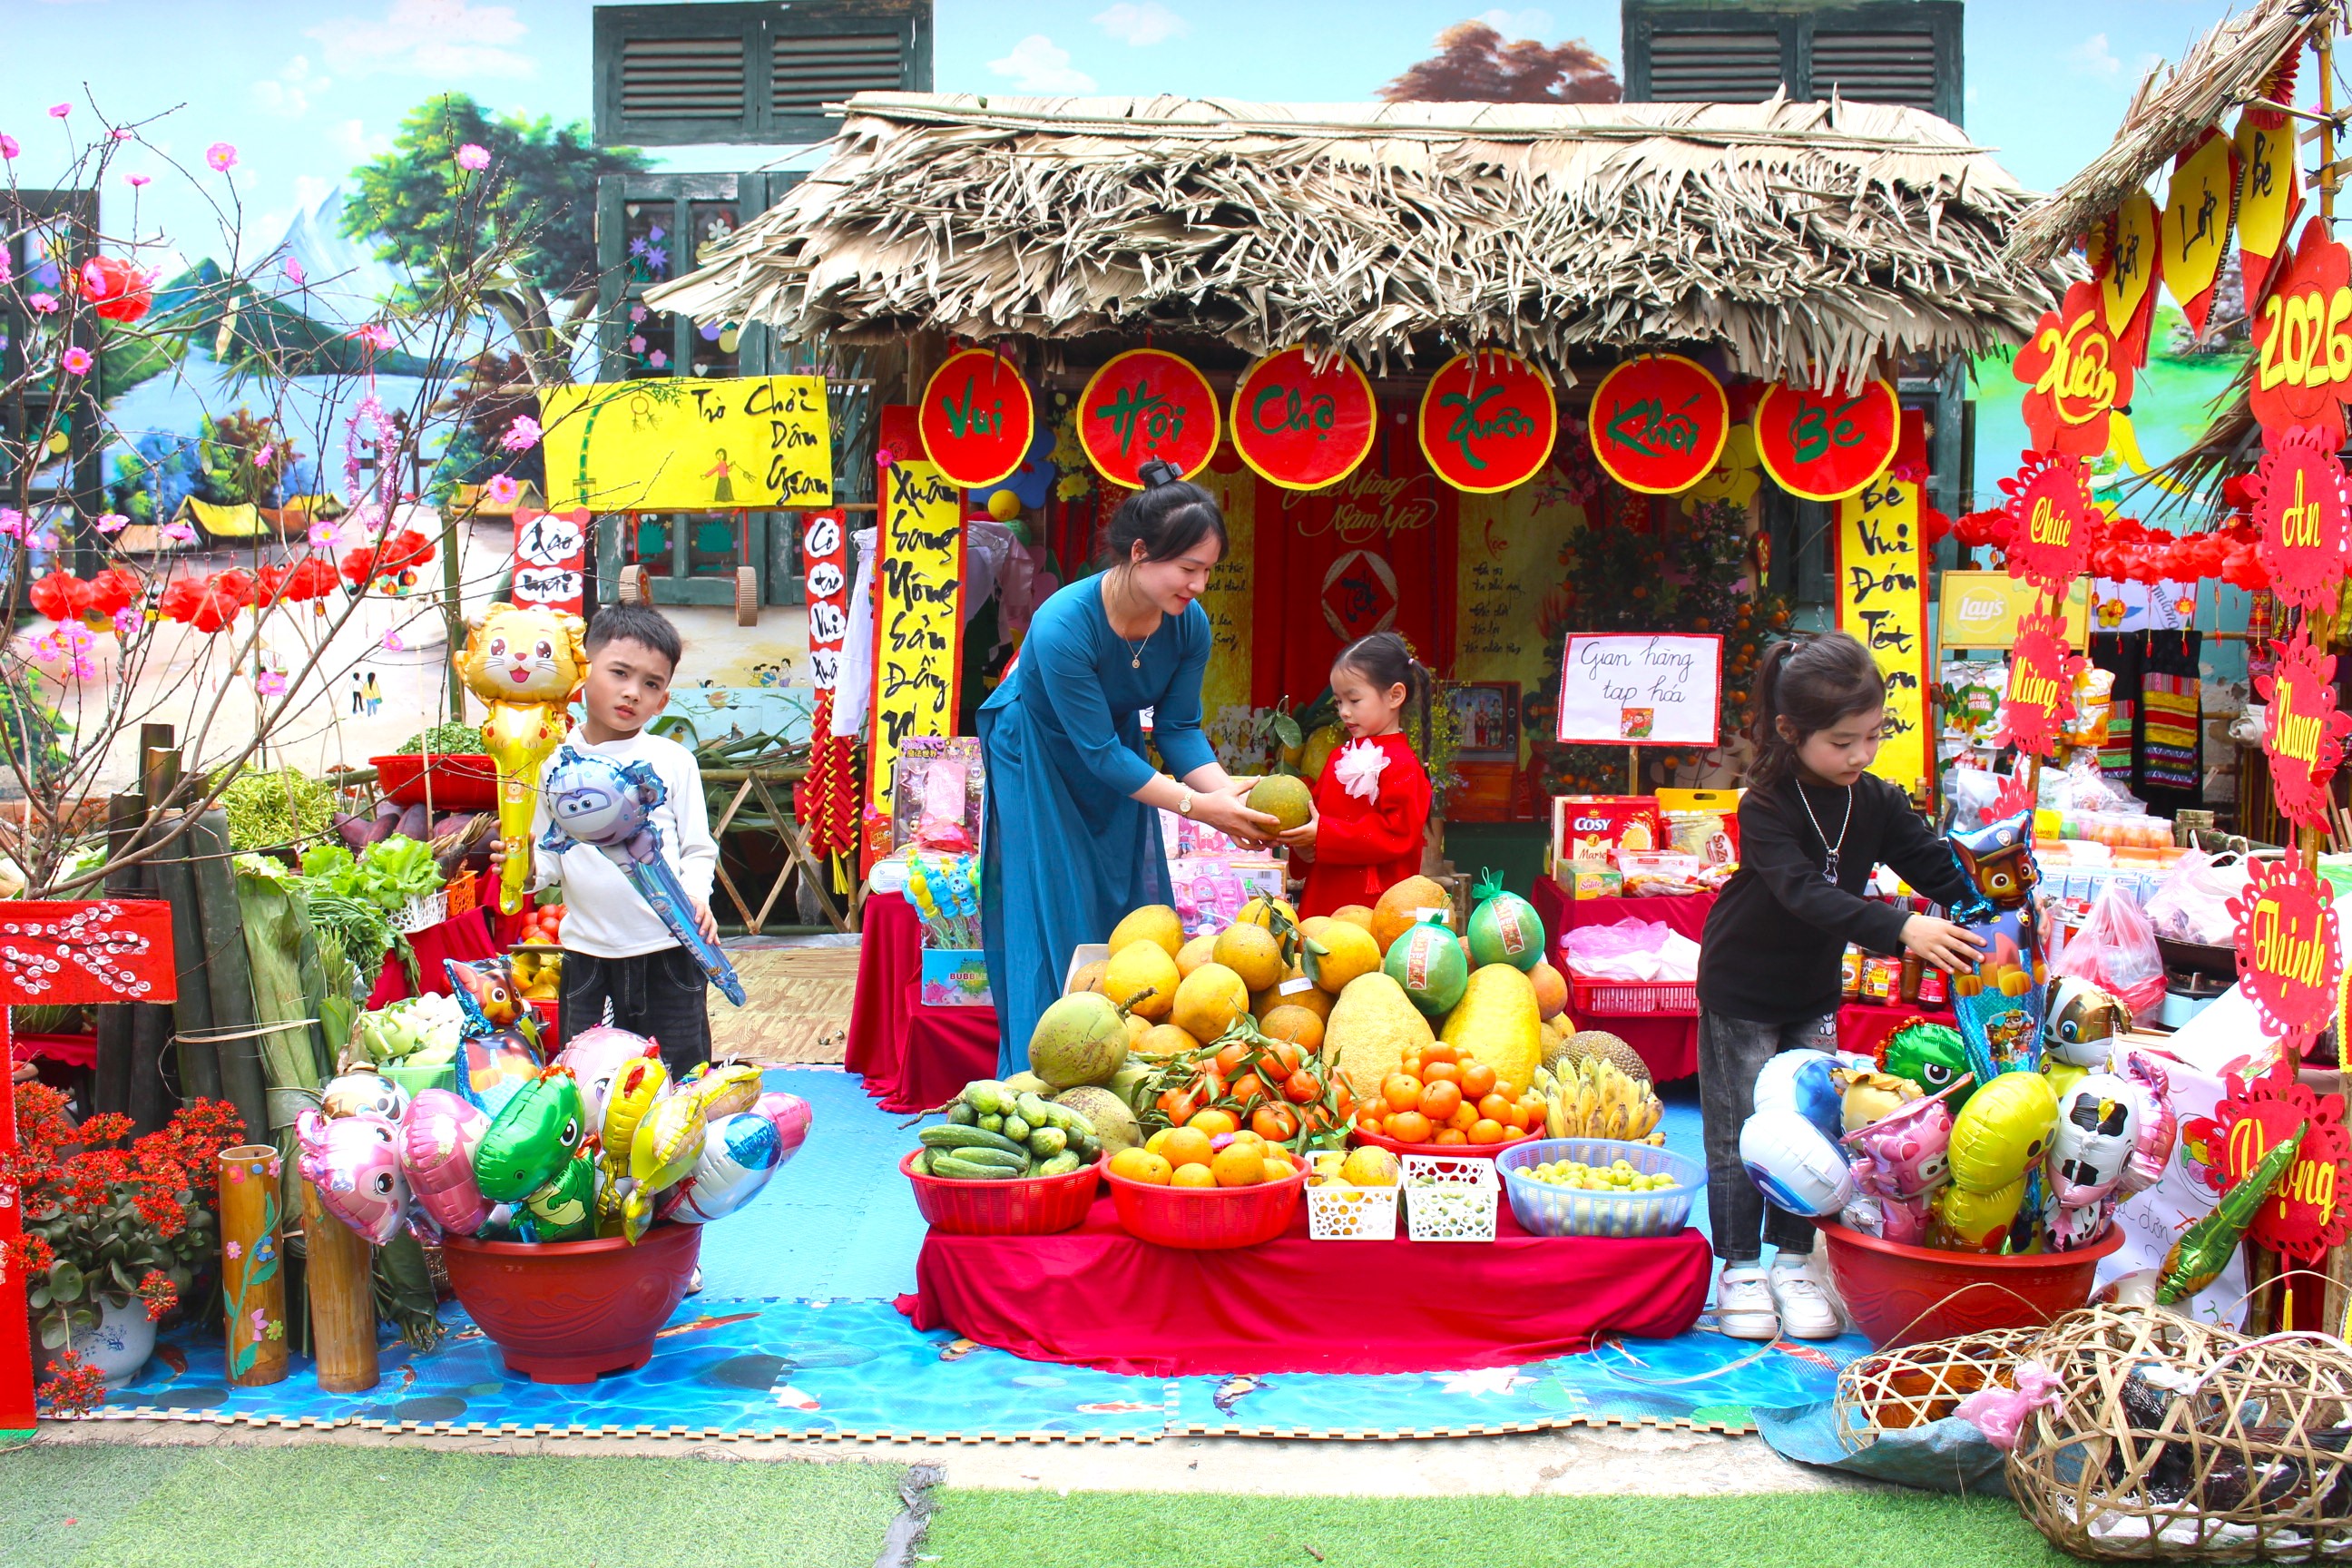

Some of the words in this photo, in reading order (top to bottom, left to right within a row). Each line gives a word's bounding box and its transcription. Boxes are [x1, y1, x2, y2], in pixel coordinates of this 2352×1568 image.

[2260, 287, 2352, 391] 2026
[2035, 309, 2116, 425] Xuân
[691, 387, 727, 423] Trò
[743, 377, 818, 416] Chơi
[942, 375, 1004, 439] Vui
[1096, 379, 1185, 458] Hội
[1251, 384, 1337, 442] Chợ
[1440, 385, 1535, 470] Xuân
[1605, 393, 1702, 458] Khối
[770, 420, 818, 449] Dân
[1788, 394, 1869, 464] Bé
[766, 454, 828, 507] Gian
[889, 461, 960, 518] Xuân
[1860, 475, 1905, 513] Bé
[2281, 468, 2321, 548] An
[811, 521, 834, 552] Cô
[2030, 495, 2073, 549] Chúc
[1849, 563, 1917, 604] Đón
[1959, 587, 2005, 621] Lay's
[812, 656, 838, 685] Xuâ
[1581, 641, 1632, 681] Gian
[1640, 636, 1694, 682] hàng
[2006, 656, 2059, 720] Mừng
[2272, 675, 2323, 782] Khang
[1573, 817, 1613, 832] COSY
[1579, 848, 1607, 860] Marie
[1580, 878, 1602, 891] Solite
[2254, 897, 2326, 999] Thịnh
[949, 972, 988, 981] BUBBLE
[2229, 1117, 2337, 1227] Vợng
